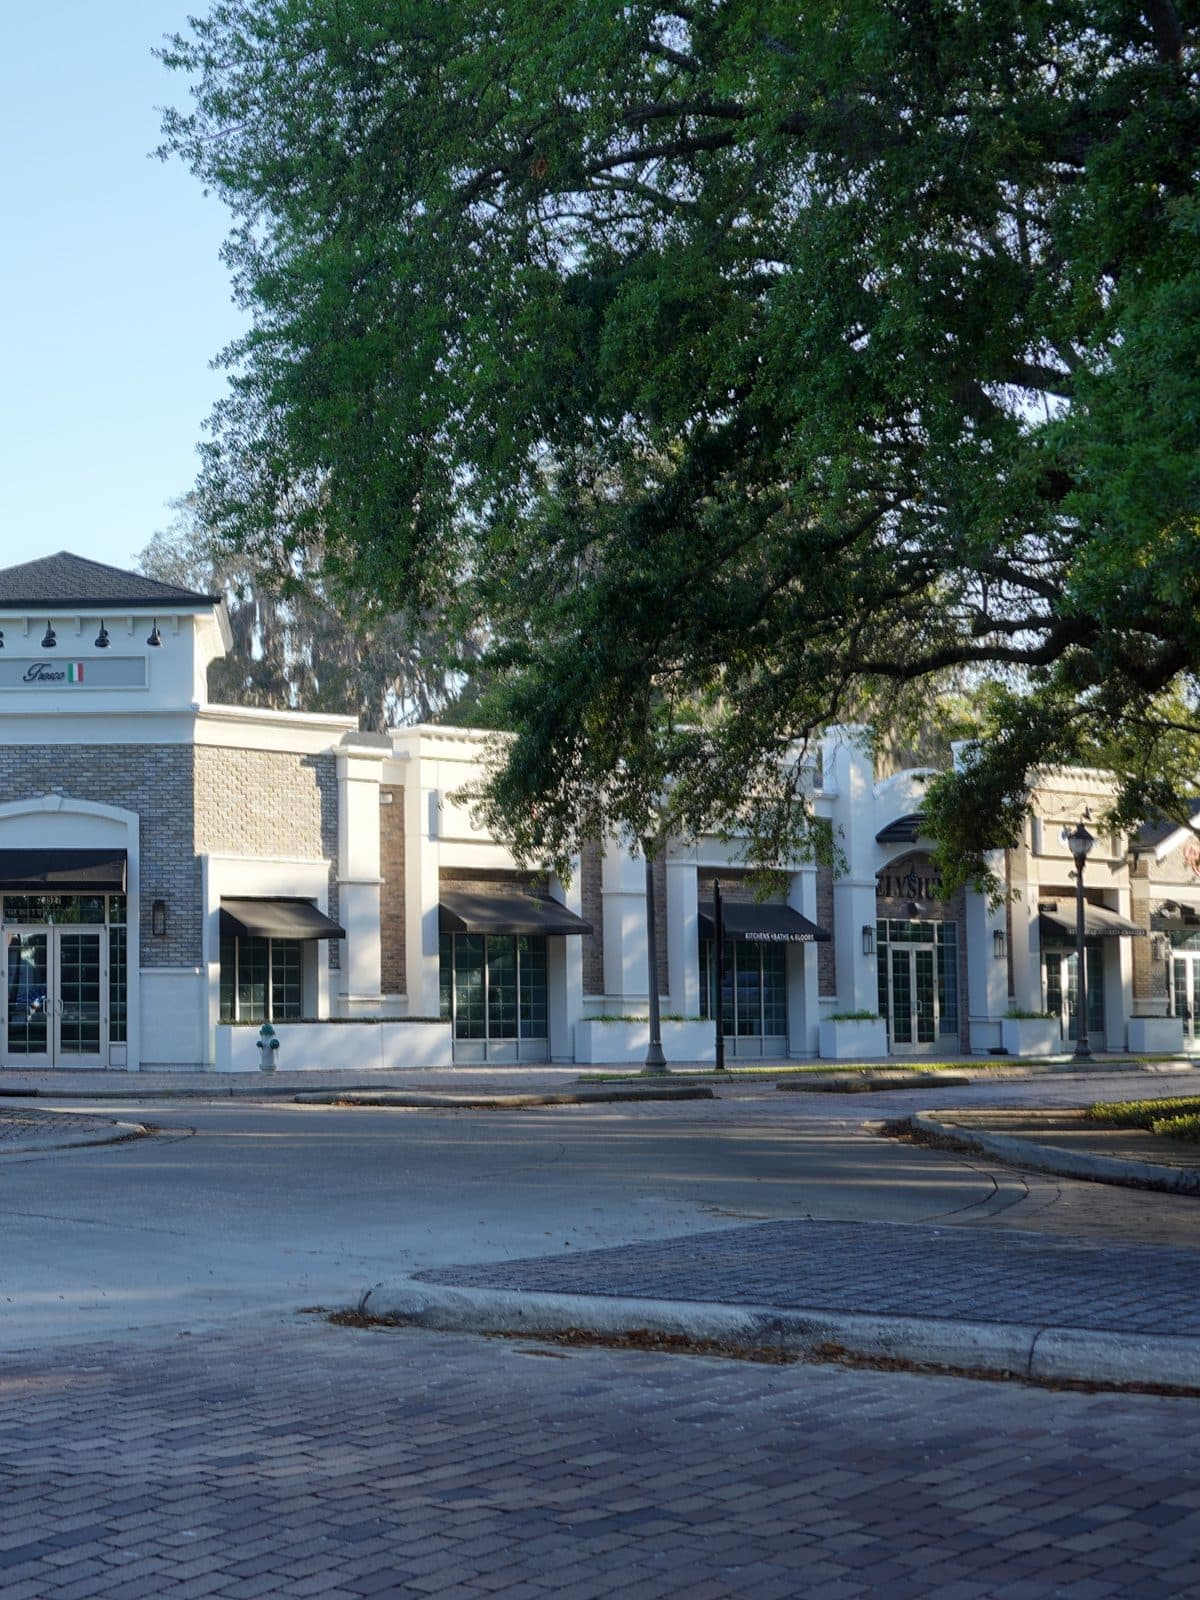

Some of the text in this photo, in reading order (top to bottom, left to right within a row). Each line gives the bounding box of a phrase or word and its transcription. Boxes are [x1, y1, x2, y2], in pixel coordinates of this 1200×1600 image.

[23, 663, 65, 681] Fresco
[876, 875, 944, 899] ELYSIU
[745, 932, 814, 942] KITCHENS BATHS FLOORS
